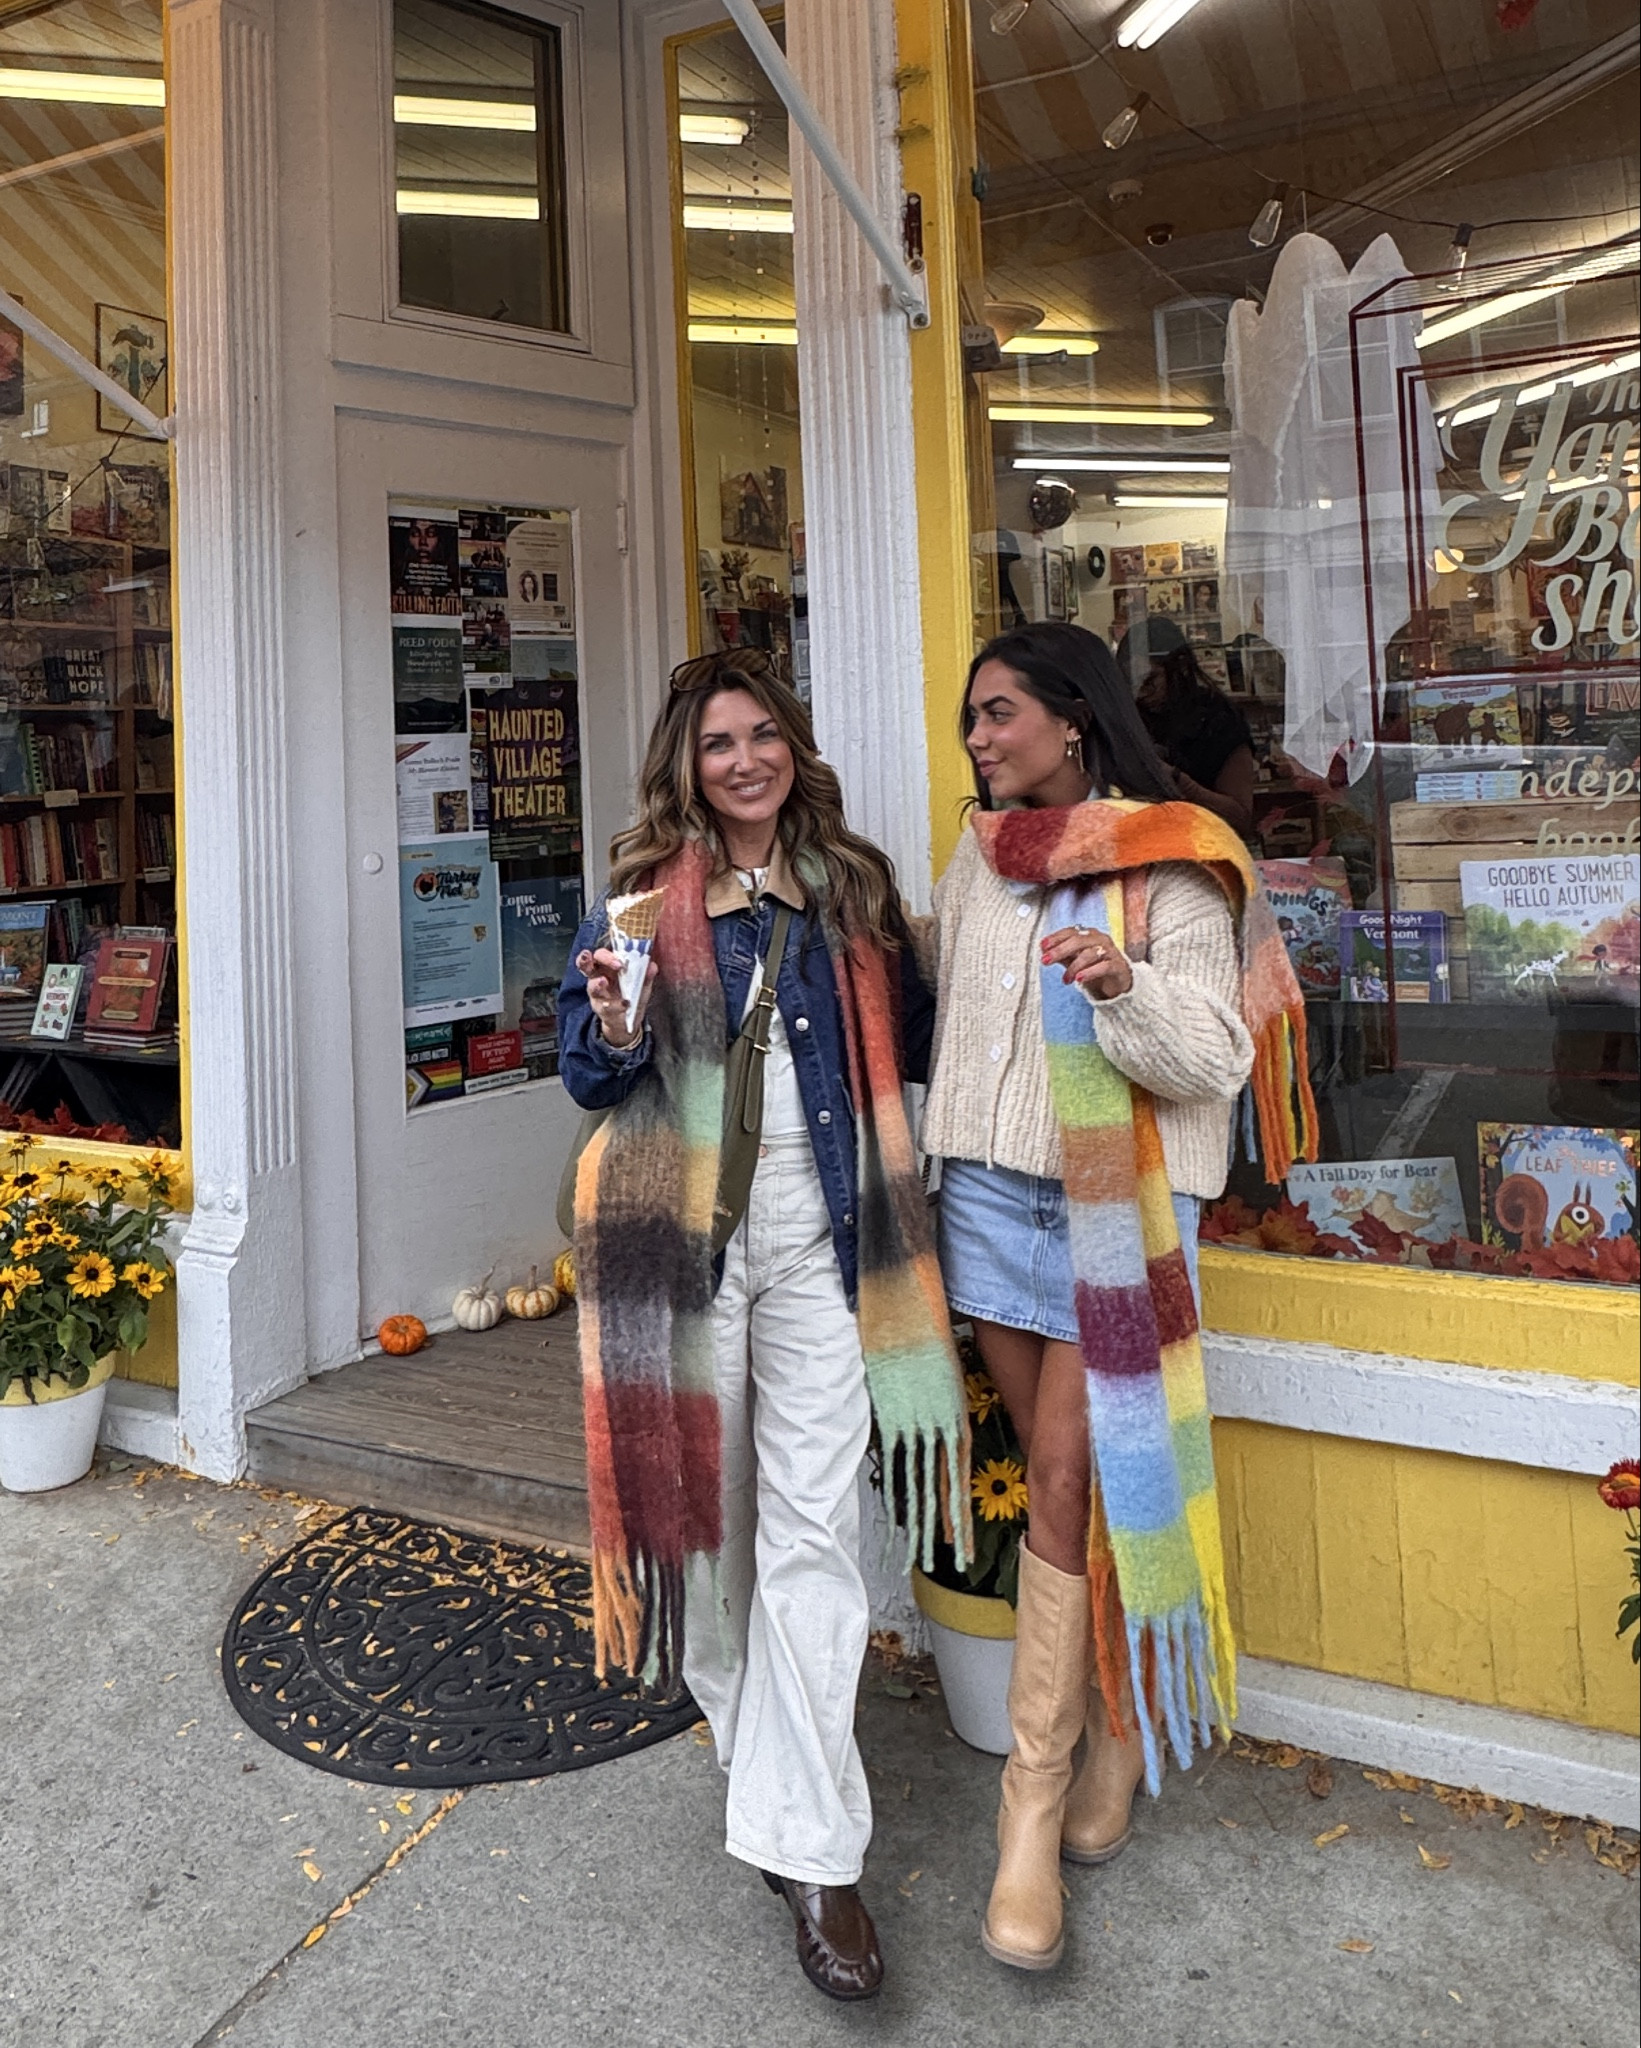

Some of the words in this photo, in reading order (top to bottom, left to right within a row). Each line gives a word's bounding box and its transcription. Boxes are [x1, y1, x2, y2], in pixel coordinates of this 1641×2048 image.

[392, 595, 434, 614] KILLING
[436, 596, 462, 616] FAITH
[1531, 561, 1640, 651] sh
[399, 637, 425, 647] REED
[66, 664, 104, 678] BLACK
[69, 679, 105, 694] HOPE
[489, 703, 565, 741] HAUNTED
[493, 741, 563, 780] VILLAGE
[1502, 756, 1640, 810] ndep
[491, 781, 566, 820] THEATER
[436, 869, 482, 887] Turkey
[1488, 864, 1558, 886] GOODBYE
[1565, 861, 1637, 882] SUMMER
[501, 893, 537, 907] Come
[1504, 887, 1550, 908] HELLO
[1558, 885, 1625, 905] AUTUMN
[516, 903, 553, 917] From
[527, 911, 563, 927] Away
[1391, 914, 1422, 927] Night
[1304, 1170, 1316, 1183] A
[1319, 1168, 1345, 1183] Fall
[1348, 1167, 1376, 1183] Day
[1380, 1166, 1400, 1179] for
[1404, 1164, 1439, 1178] Bear
[1526, 1156, 1564, 1173] LEAF
